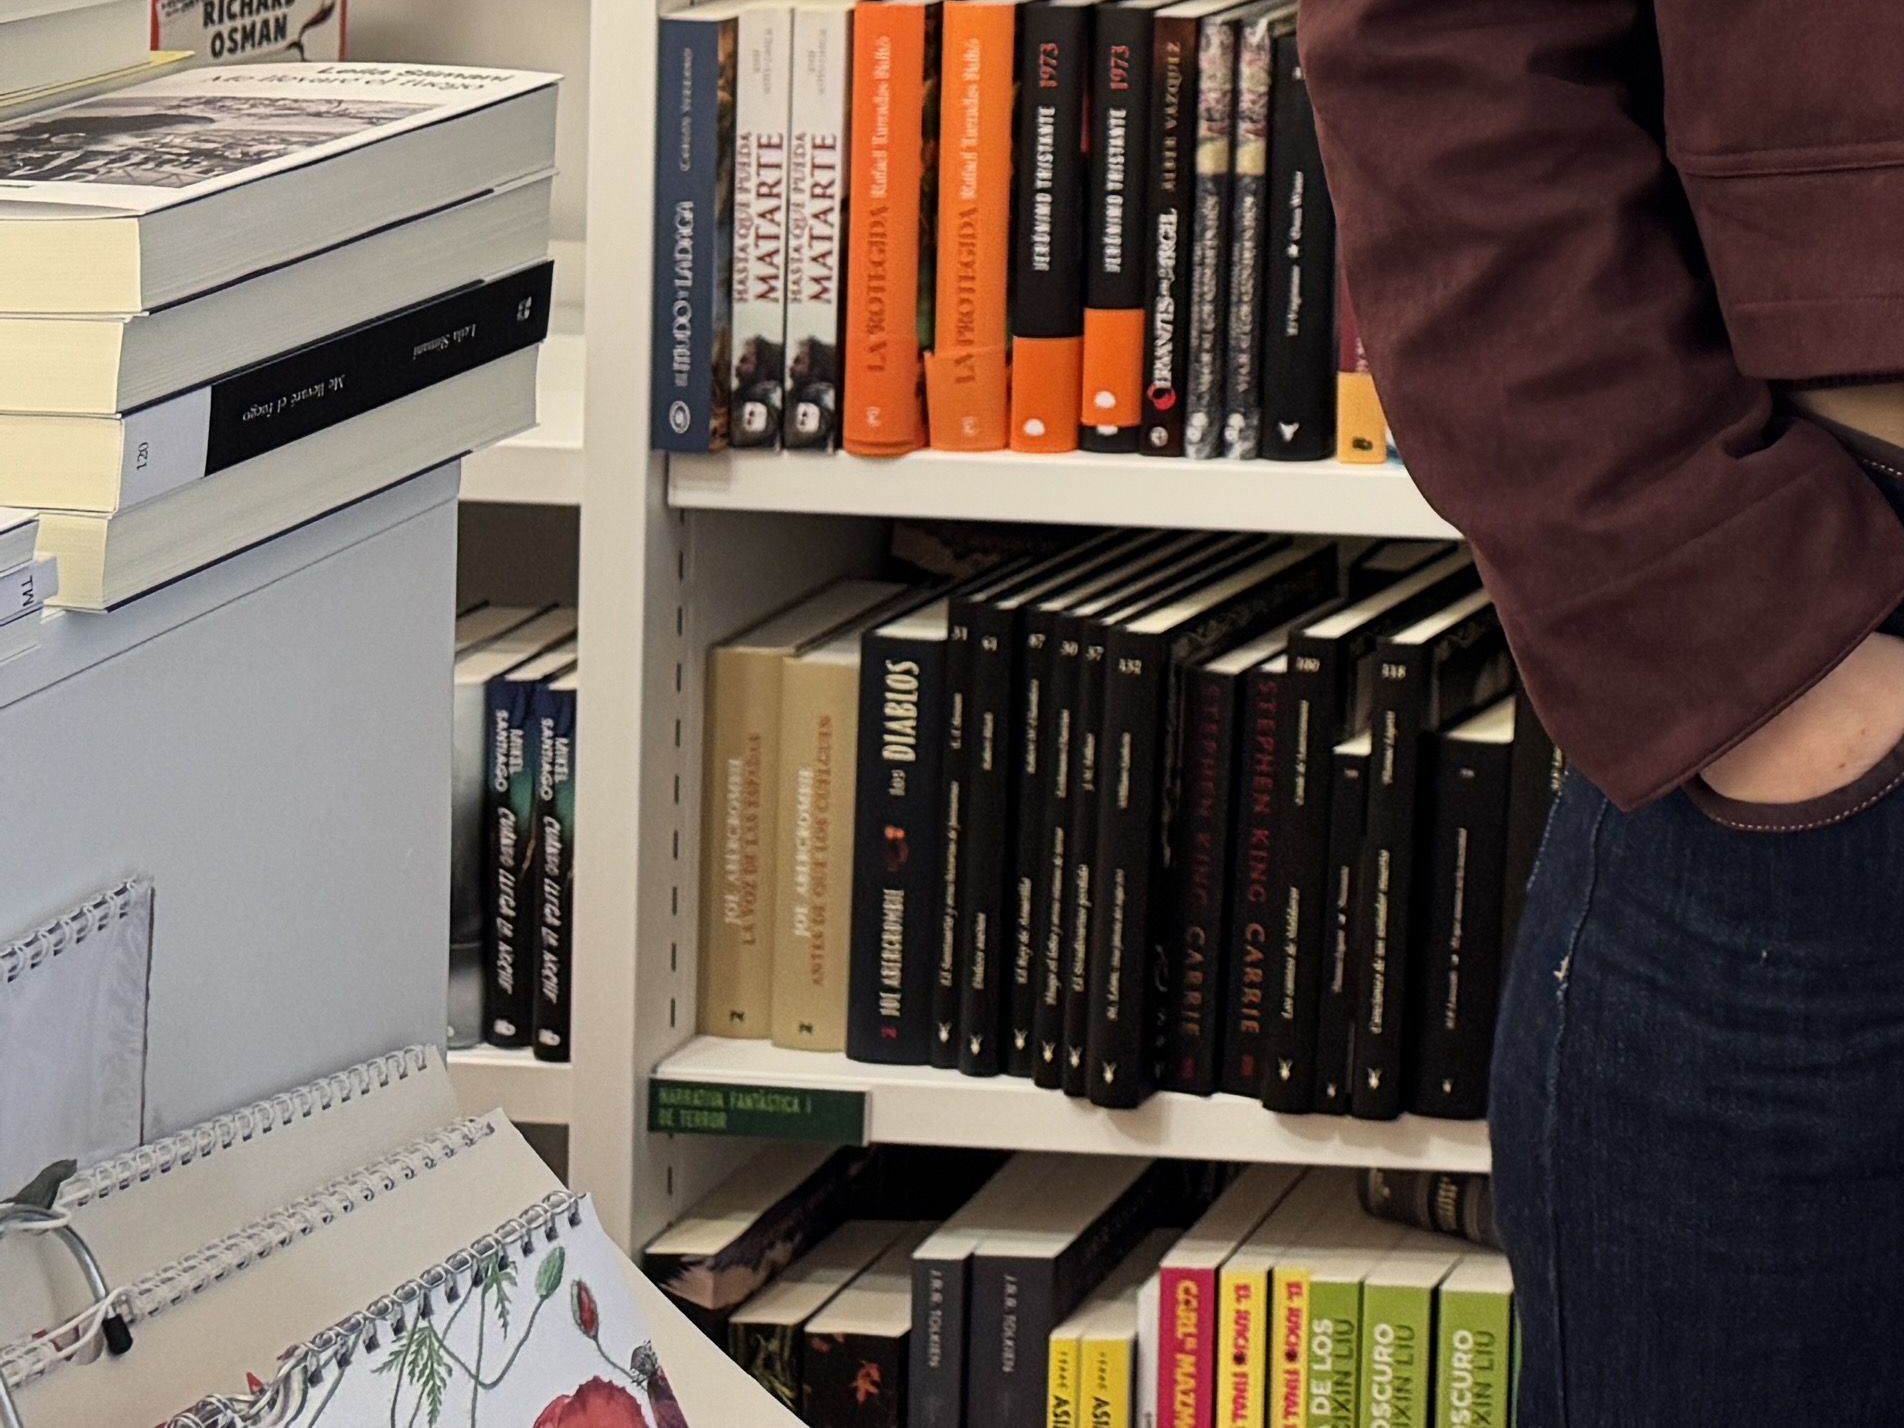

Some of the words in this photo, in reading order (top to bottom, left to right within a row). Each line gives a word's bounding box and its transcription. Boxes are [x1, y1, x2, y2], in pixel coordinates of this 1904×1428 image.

[210, 15, 288, 58] OSMAN
[1039, 43, 1059, 89] 1973
[755, 133, 784, 304] MATARTE
[882, 659, 920, 763] DIABLOS
[1312, 1318, 1335, 1369] LOS
[1397, 1324, 1416, 1368] LIU
